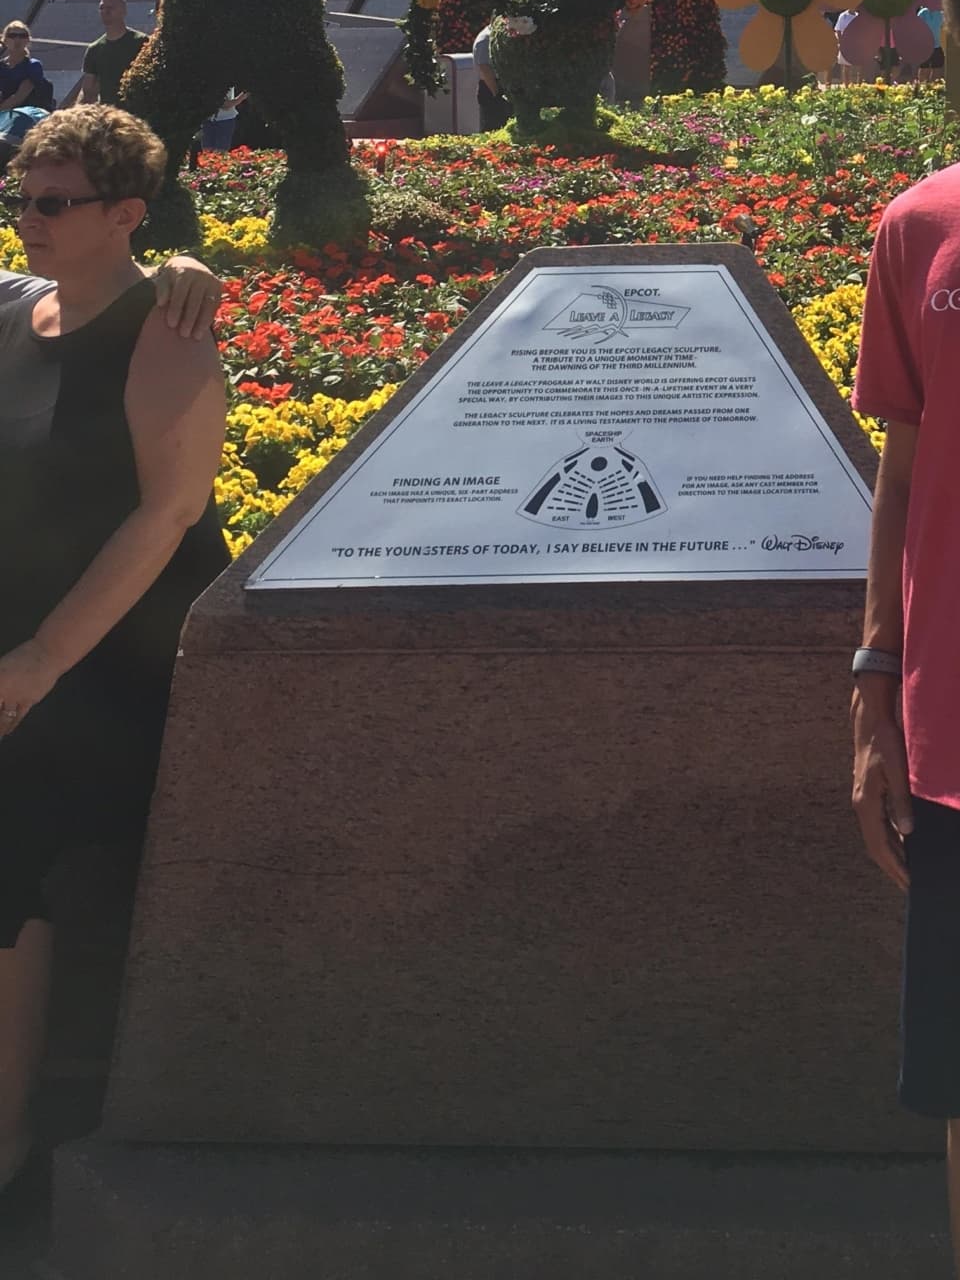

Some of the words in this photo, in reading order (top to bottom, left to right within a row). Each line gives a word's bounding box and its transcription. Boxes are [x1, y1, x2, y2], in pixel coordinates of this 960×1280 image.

[569, 311, 605, 322] LEAVE
[608, 312, 619, 322] A
[630, 310, 675, 321] LEGACY
[392, 477, 441, 487] FINDING
[443, 477, 460, 486] AN
[463, 476, 500, 486] IMAGE
[357, 548, 381, 557] THE
[472, 545, 490, 555] OF
[492, 544, 541, 555] TODAY,
[546, 544, 551, 553] I
[553, 544, 580, 553] SAY
[582, 543, 632, 553] BELIEVE
[635, 542, 649, 552] IN
[652, 542, 677, 552] THE
[679, 541, 729, 551] FUTURE
